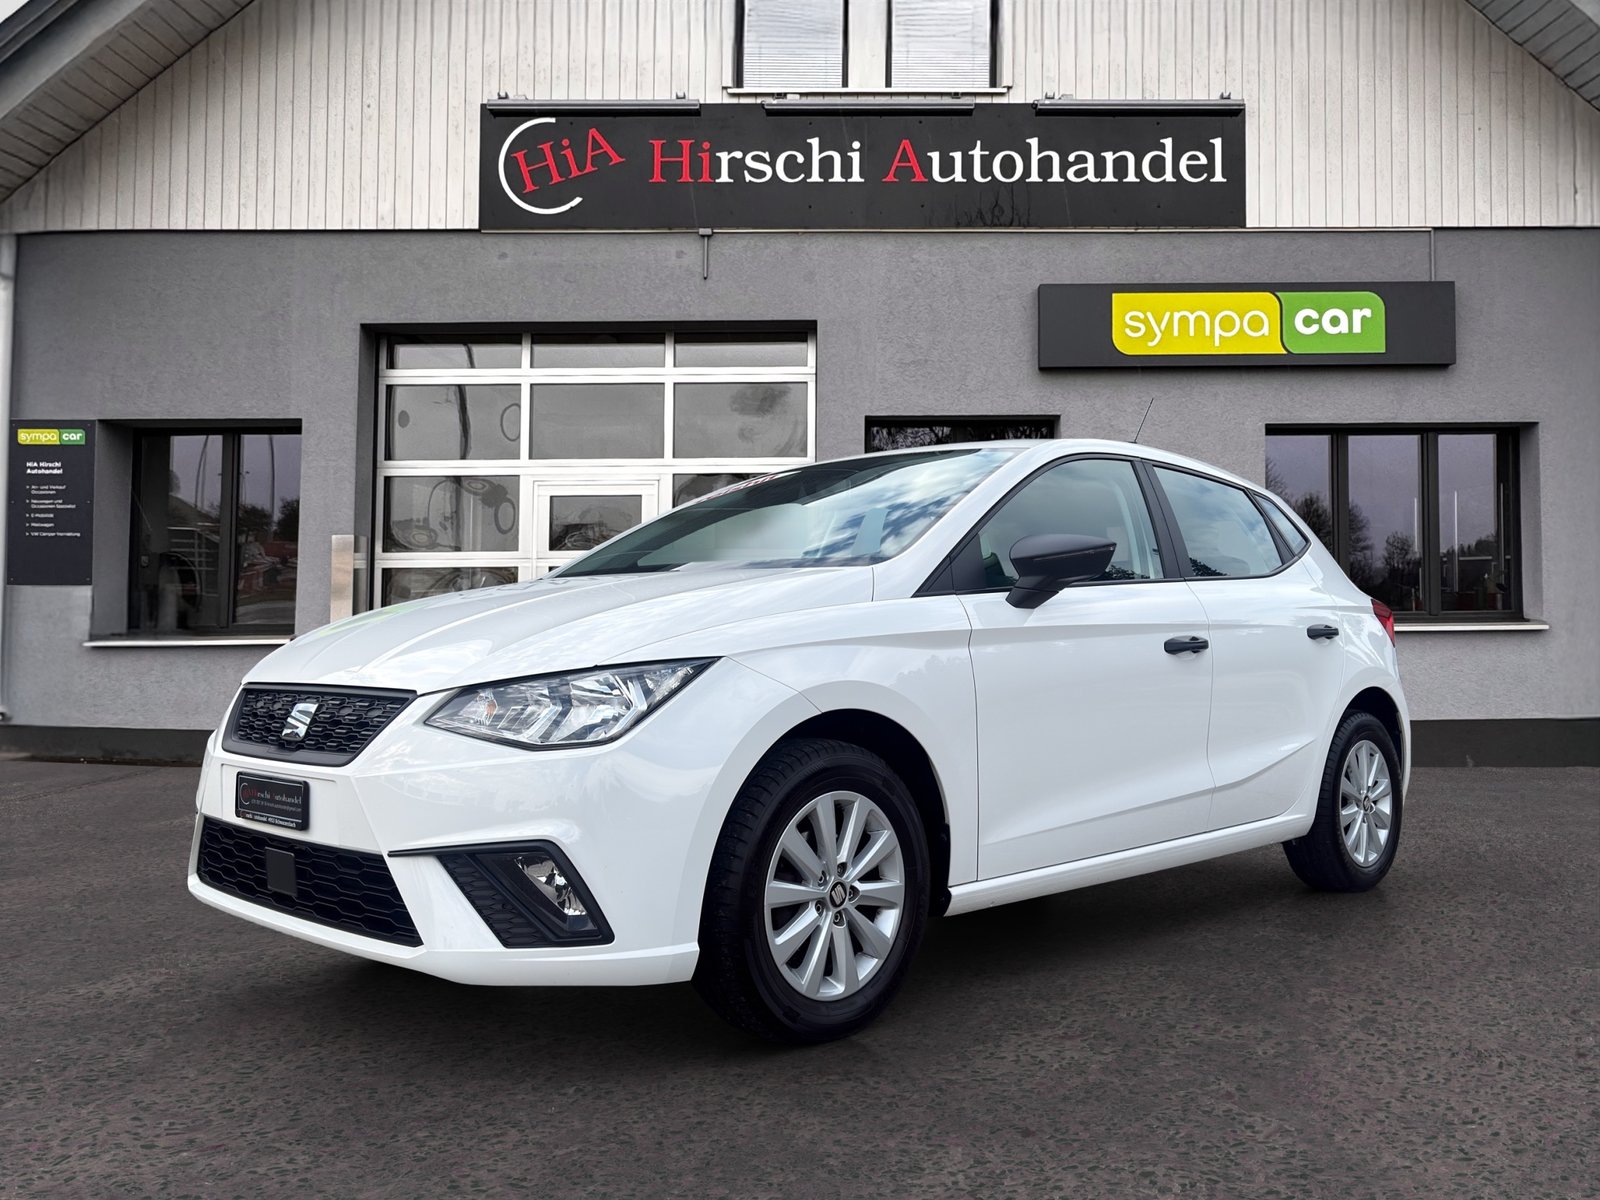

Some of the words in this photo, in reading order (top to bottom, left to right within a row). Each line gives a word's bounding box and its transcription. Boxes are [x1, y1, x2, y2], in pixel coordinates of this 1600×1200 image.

[511, 127, 626, 193] HiA
[648, 137, 865, 184] Hirschi
[882, 137, 1227, 184] Autohandel
[1124, 310, 1270, 347] sympa
[1294, 308, 1372, 335] car
[20, 433, 57, 443] sympa
[62, 433, 82, 441] car
